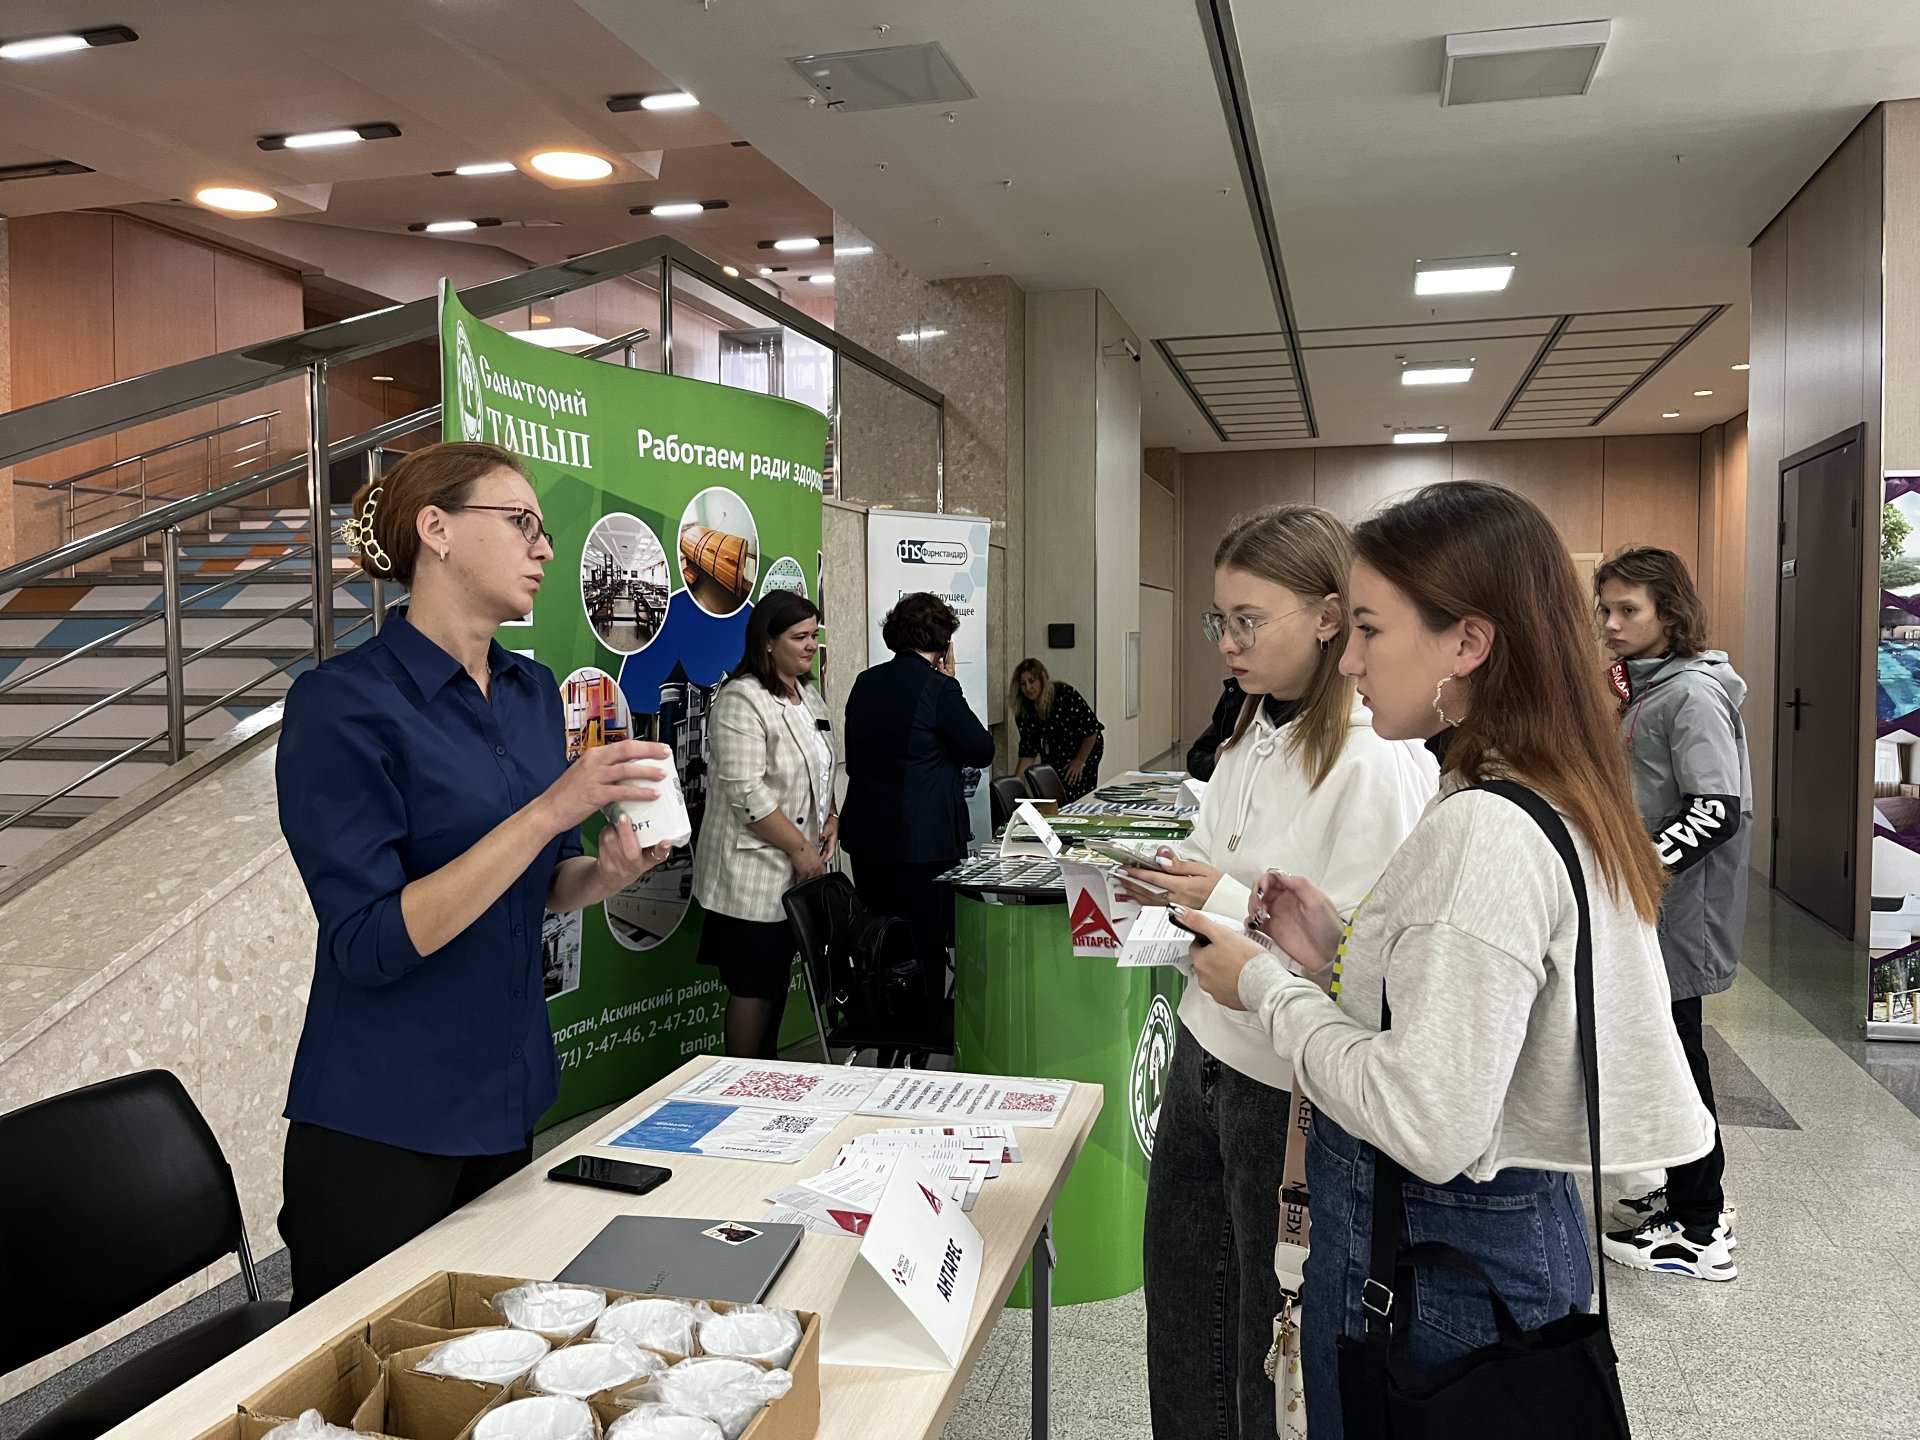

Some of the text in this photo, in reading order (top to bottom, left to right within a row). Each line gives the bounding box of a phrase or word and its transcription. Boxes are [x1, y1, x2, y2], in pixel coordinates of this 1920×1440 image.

[479, 354, 587, 419] Санаторий
[486, 406, 592, 468] ТАНЫП
[637, 429, 744, 471] Работаем
[751, 453, 790, 480] ради
[922, 548, 966, 559] Фармстандарт
[632, 820, 650, 832] OFT
[1072, 935, 1117, 949] АНТАРЕС
[552, 979, 722, 1045] тостан, Аскинский район,
[558, 1046, 581, 1071] 71)
[585, 1025, 645, 1060] 2-47-46,
[648, 1006, 709, 1038] 2-47-20,
[1286, 1204, 1303, 1235] KEE
[936, 1237, 963, 1303] АНТАРЕС
